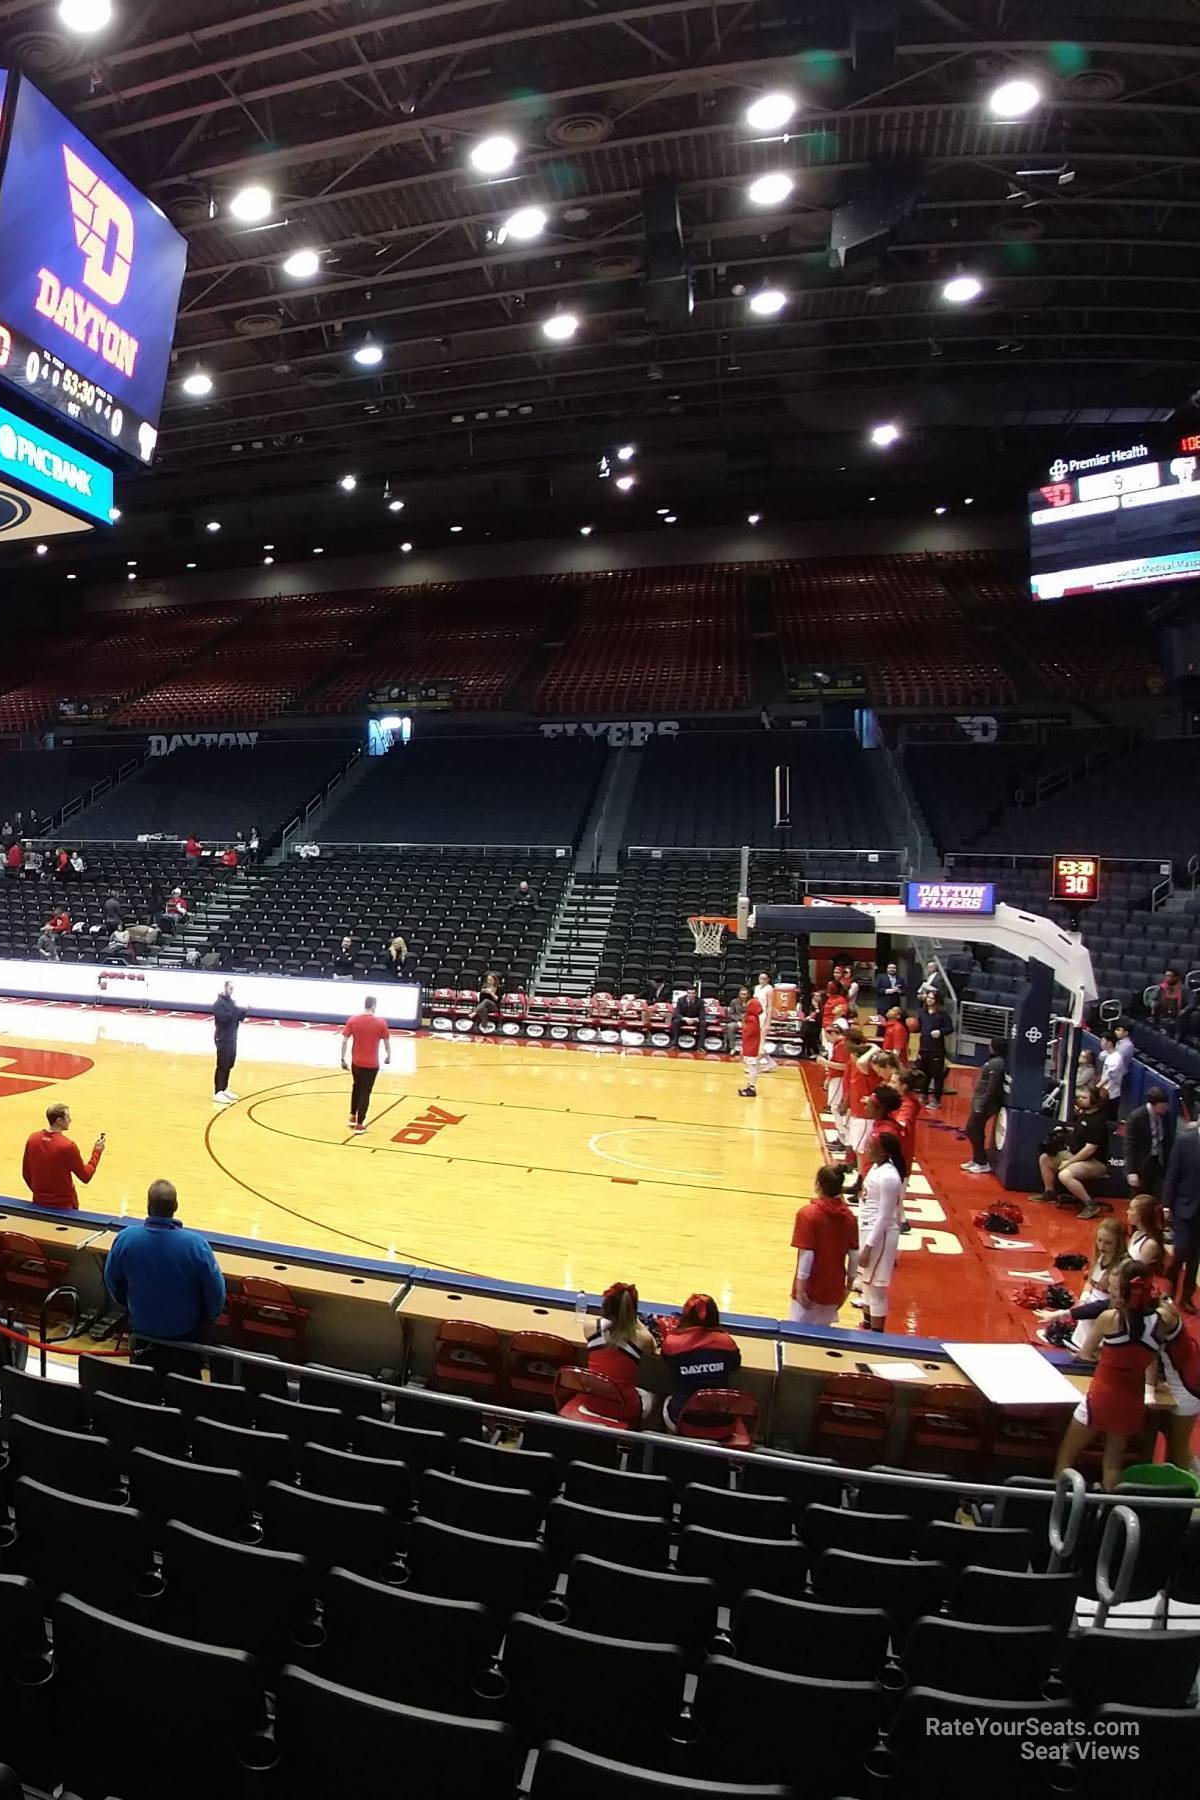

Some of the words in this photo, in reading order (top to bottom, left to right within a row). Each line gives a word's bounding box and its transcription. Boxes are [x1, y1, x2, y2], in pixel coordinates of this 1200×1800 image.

[35, 267, 140, 378] DAYTON
[26, 351, 40, 383] 0
[62, 368, 96, 407] 53:30
[111, 408, 123, 437] 0
[16, 434, 53, 479] PNC
[51, 451, 95, 498] BANK
[1068, 454, 1111, 472] Premier
[1112, 444, 1148, 463] Health
[148, 731, 259, 757] DAYTON
[1058, 860, 1095, 876] 53:30
[917, 885, 986, 898] DAYTON
[1065, 875, 1088, 893] 30
[919, 897, 982, 910] FLYERS
[680, 1362, 725, 1375] DAYTON
